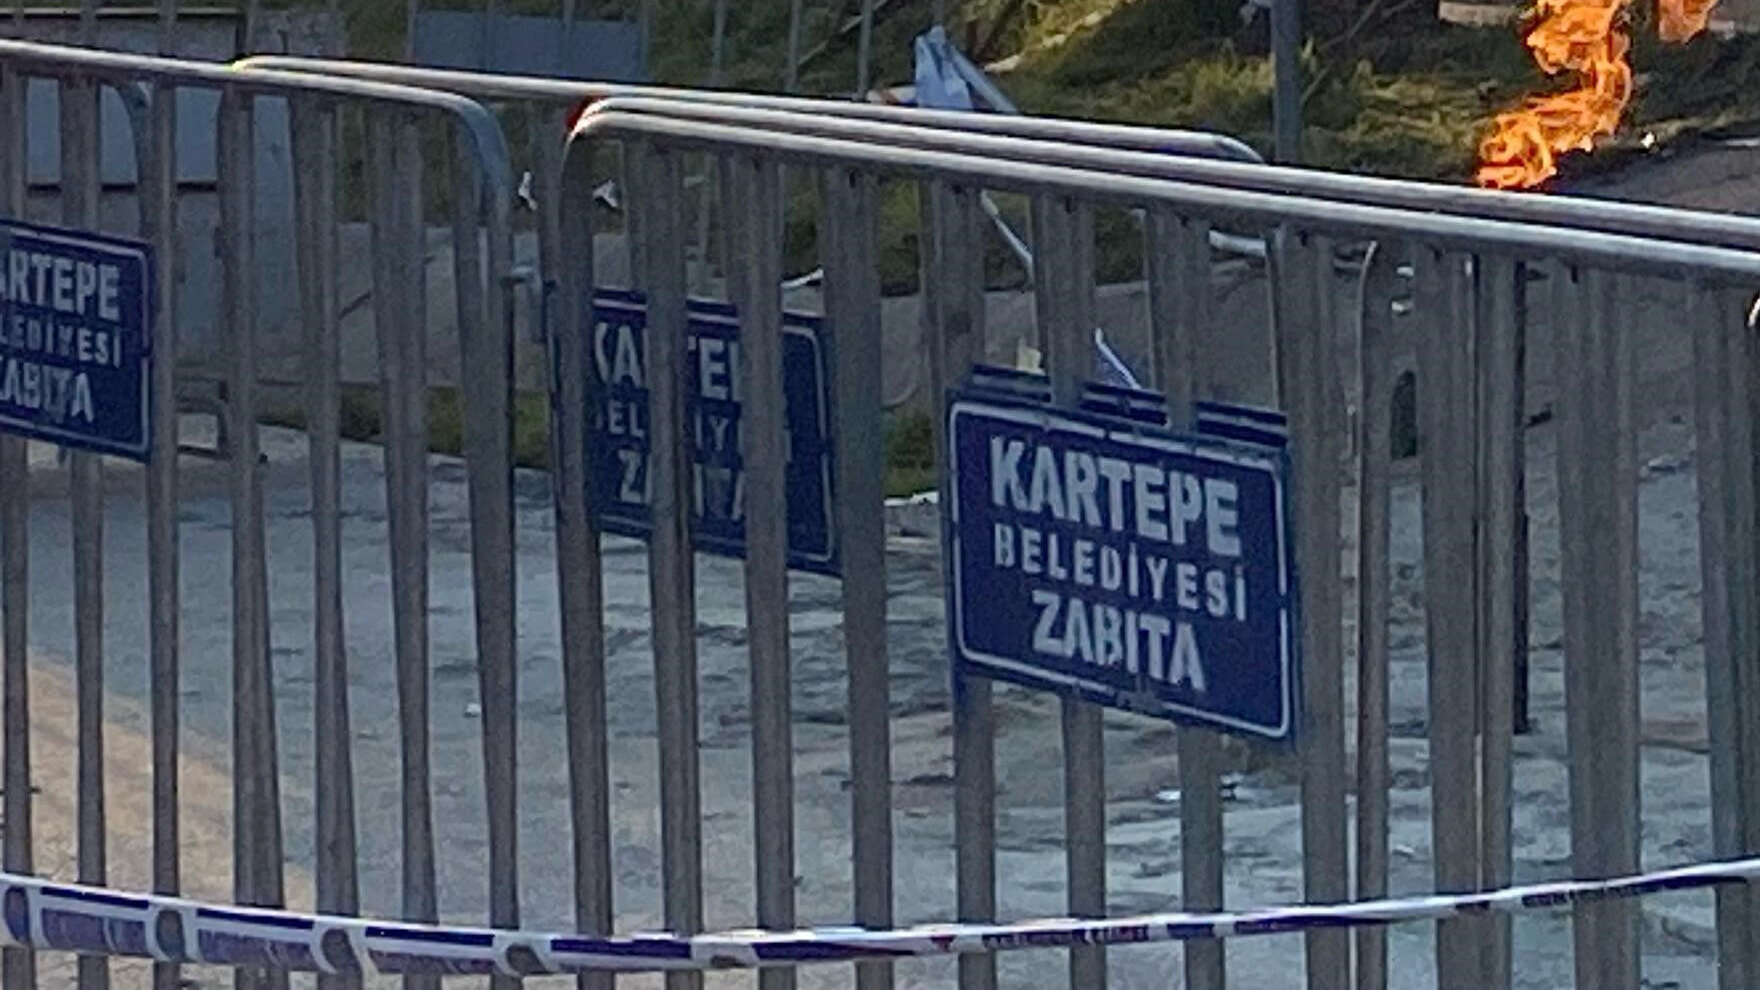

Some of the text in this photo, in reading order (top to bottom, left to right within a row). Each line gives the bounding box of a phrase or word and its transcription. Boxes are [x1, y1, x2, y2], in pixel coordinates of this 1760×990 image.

[0, 248, 121, 322] RTEPE
[989, 434, 1242, 557] KARTEPE
[993, 522, 1247, 622] BELEDİYESİ
[1031, 589, 1206, 692] ZABITA
